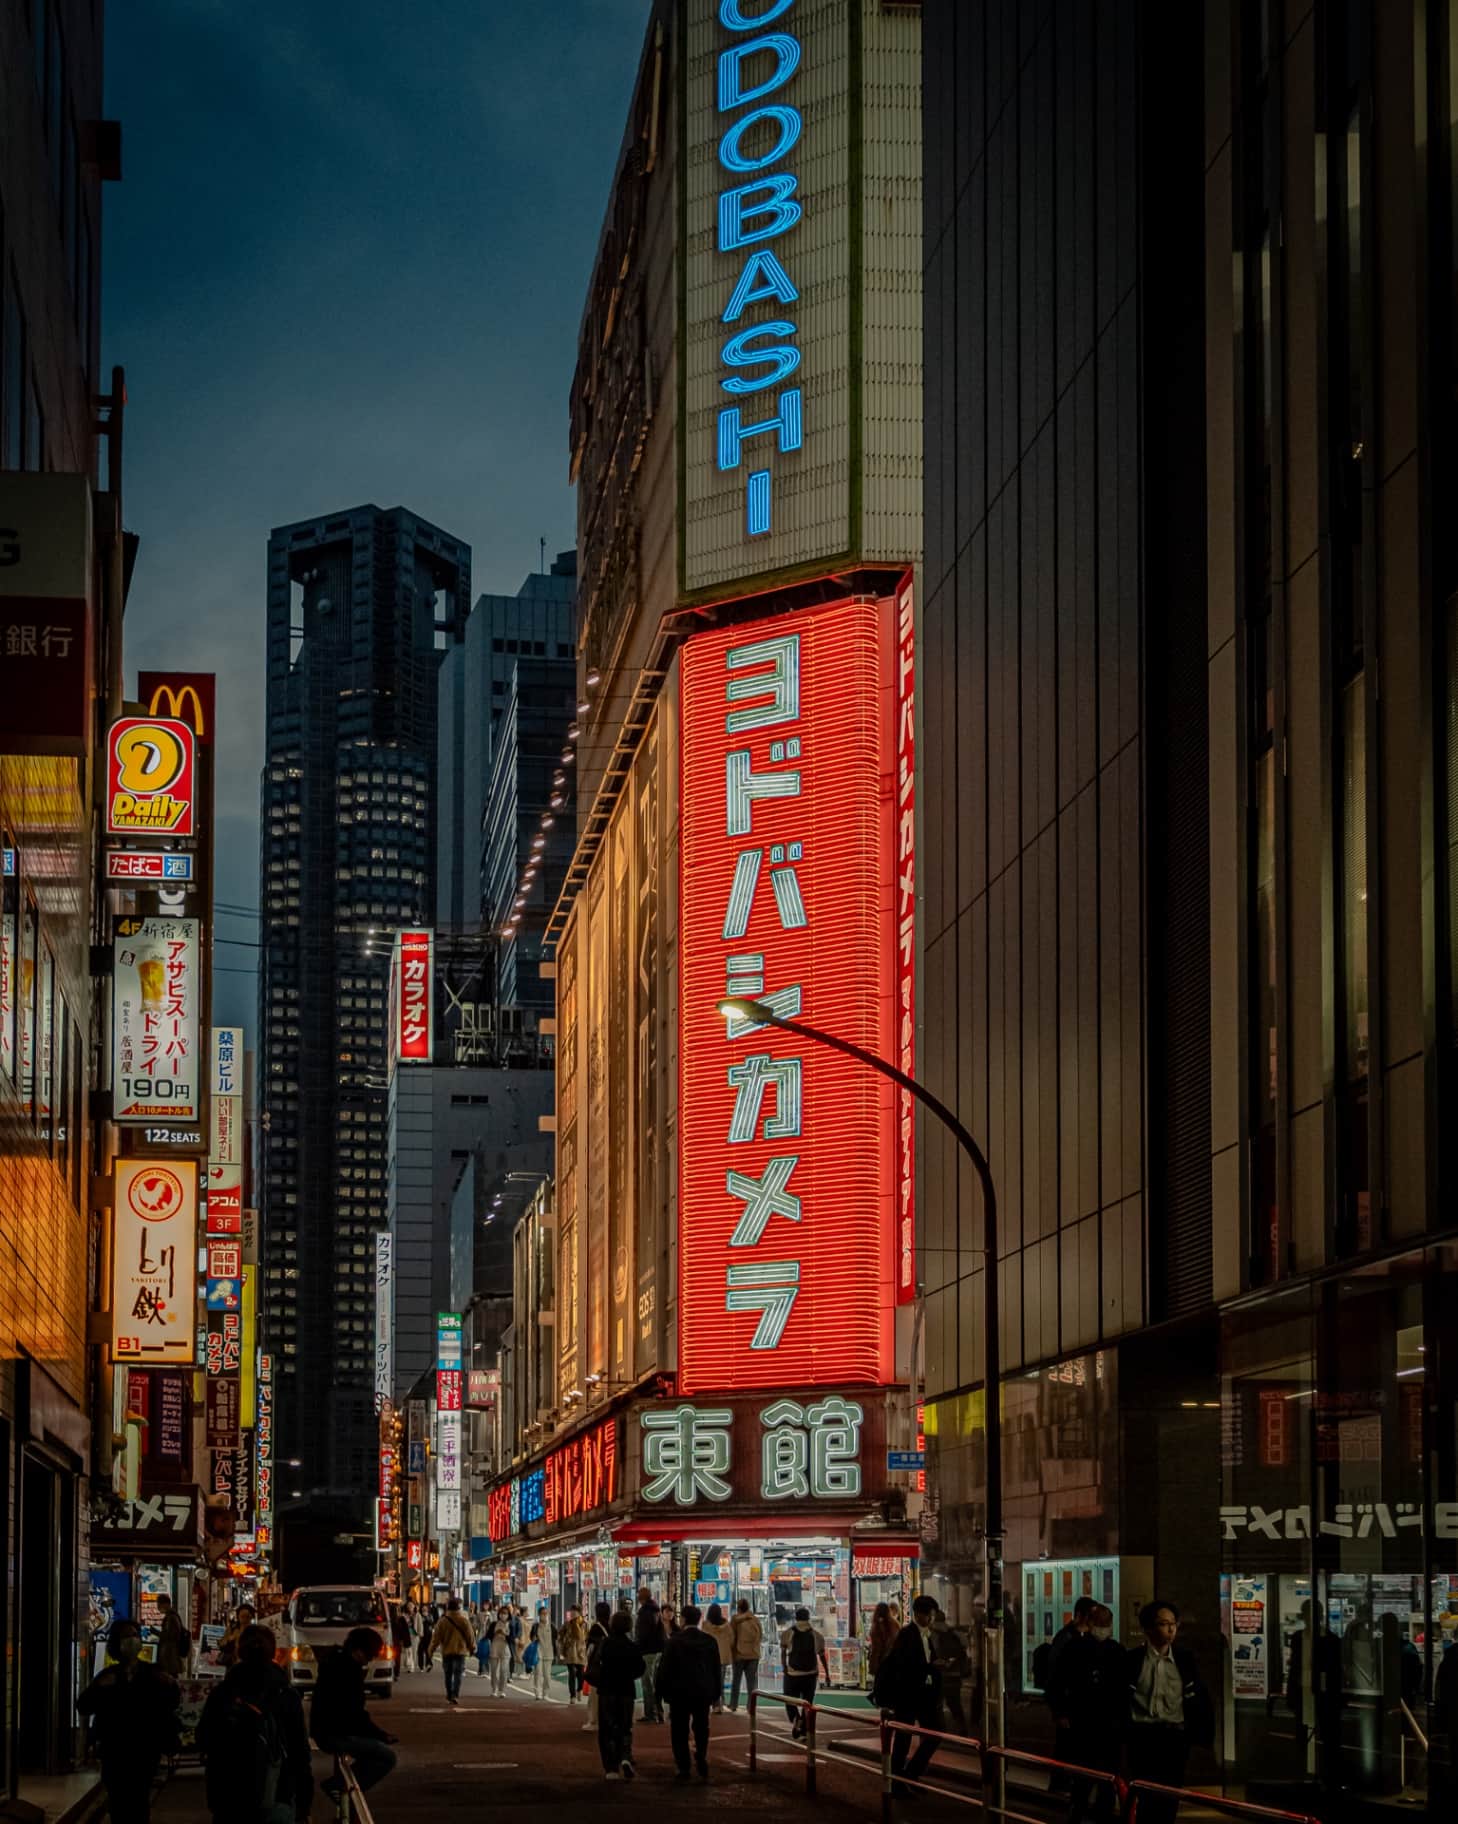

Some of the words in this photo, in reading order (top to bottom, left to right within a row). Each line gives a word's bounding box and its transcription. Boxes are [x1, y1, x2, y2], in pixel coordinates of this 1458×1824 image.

[0, 623, 73, 658] 銀行
[113, 794, 186, 828] Daily
[114, 815, 166, 826] YAMAZAKI
[111, 857, 161, 875] たばこ
[167, 858, 187, 876] 酒
[118, 918, 142, 936] 4F
[166, 941, 187, 1076] アサヒスーパー
[403, 959, 427, 1044] カラオケ
[724, 633, 809, 1350] ヨドバシカメラ
[120, 1035, 133, 1075] 居酒屋
[140, 1013, 159, 1076] ドライ
[218, 1031, 233, 1092] 桑原ビル
[122, 1079, 190, 1099] 190円
[145, 1128, 170, 1143] 122
[170, 1132, 200, 1143] SEATS
[209, 1196, 240, 1207] アコム
[216, 1219, 232, 1230] 3F
[377, 1237, 391, 1288] カラオケ
[117, 1338, 140, 1350] B1
[207, 1332, 222, 1374] カメラ
[223, 1314, 239, 1370] ヨドバシ
[640, 1395, 864, 1506] 東館
[545, 1416, 618, 1526] ヨドバシカメラ
